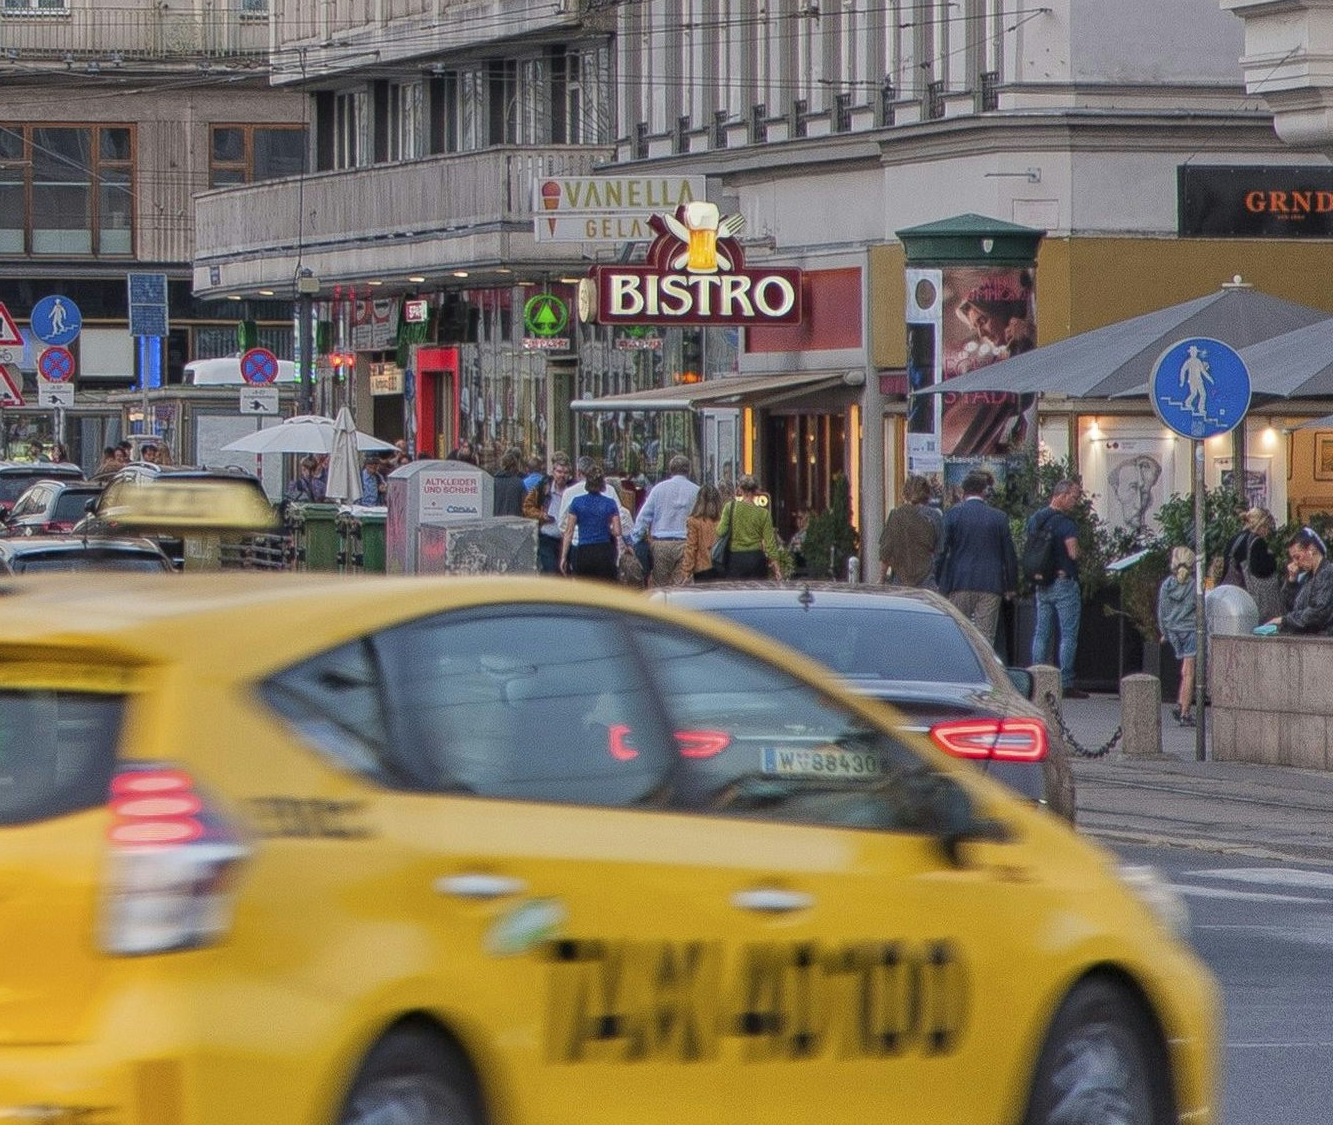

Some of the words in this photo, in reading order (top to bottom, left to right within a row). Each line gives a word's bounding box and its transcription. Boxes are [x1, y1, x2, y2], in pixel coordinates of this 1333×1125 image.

[564, 179, 695, 208] VANELLA
[609, 274, 795, 317] BISTRO
[424, 486, 442, 494] UND
[443, 486, 478, 494] SCHUHE
[425, 478, 477, 486] ALTKLEIDER
[779, 752, 794, 770] W
